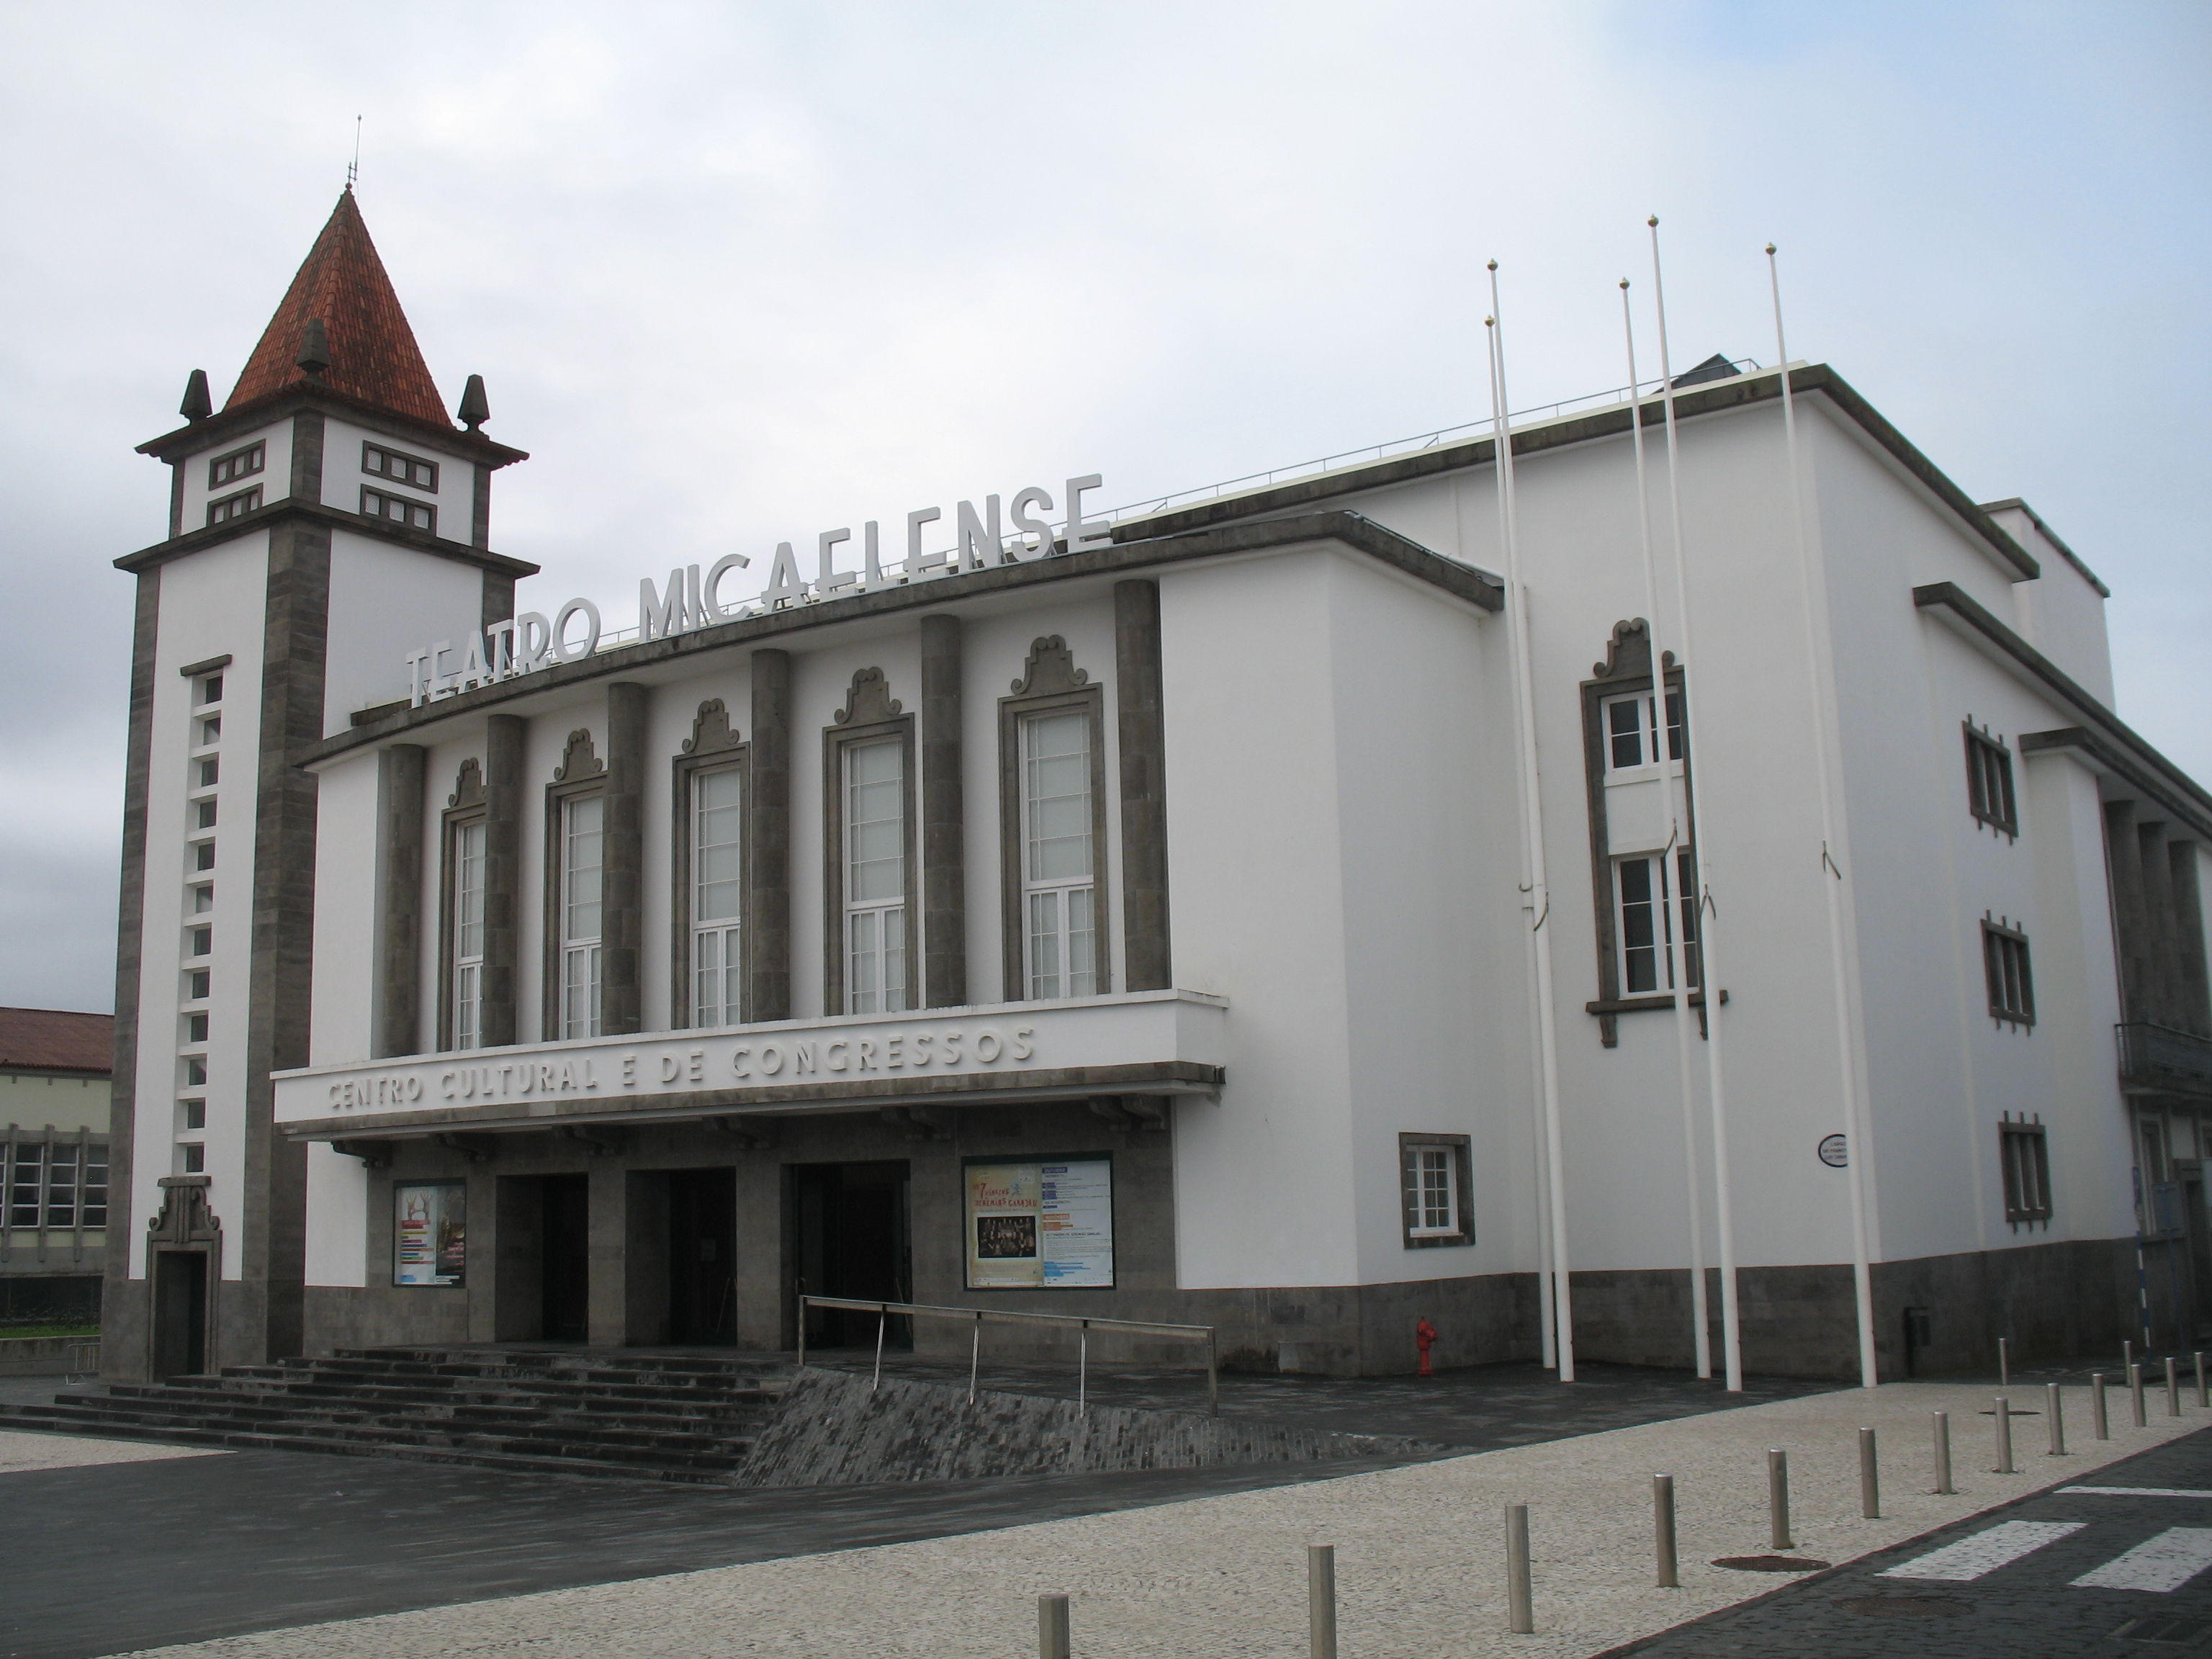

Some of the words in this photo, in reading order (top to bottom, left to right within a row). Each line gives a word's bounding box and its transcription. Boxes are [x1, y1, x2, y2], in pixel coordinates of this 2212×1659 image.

[405, 597, 601, 709] TEATRO
[639, 473, 1113, 644] MICAELENSE
[328, 1076, 423, 1109] CENTRO
[441, 1058, 598, 1099] CULTURAL
[622, 1055, 637, 1085] E
[661, 1050, 703, 1083] DE
[731, 1027, 1034, 1078] CONGRESSOS
